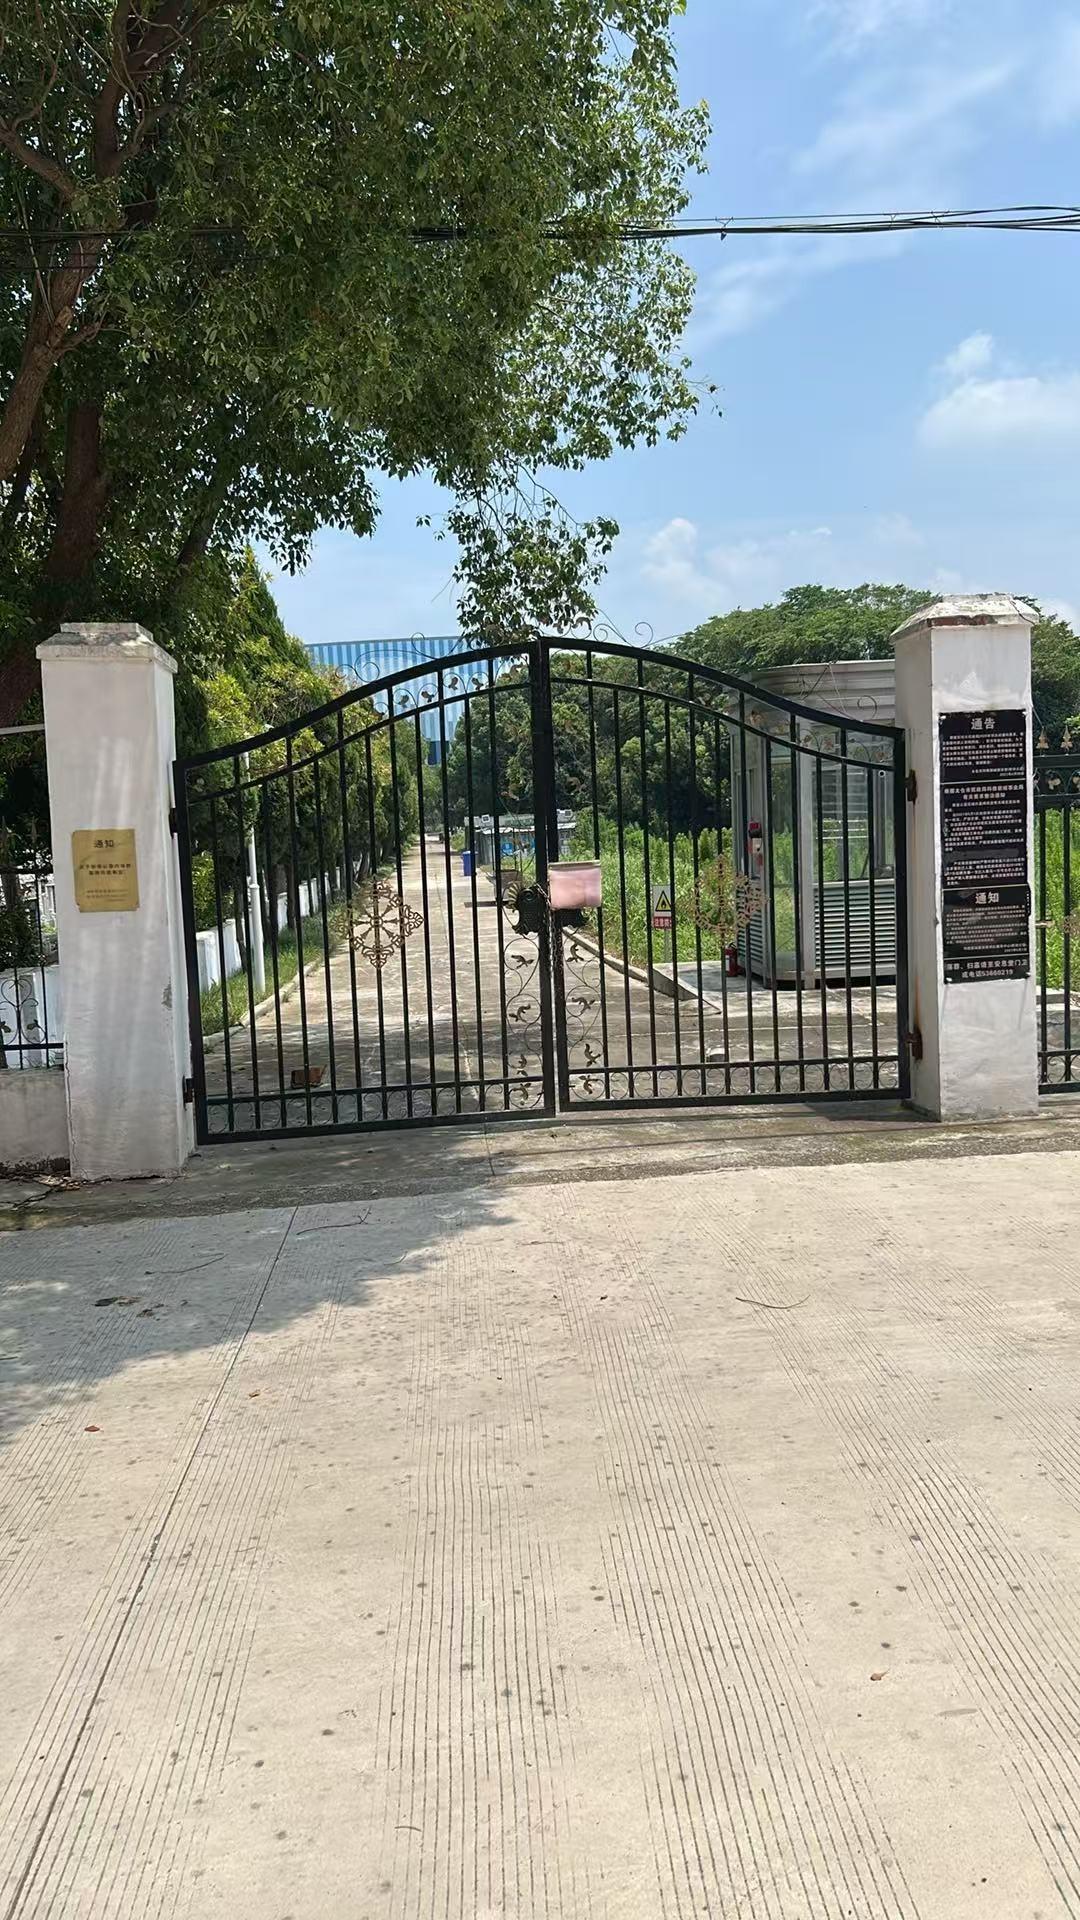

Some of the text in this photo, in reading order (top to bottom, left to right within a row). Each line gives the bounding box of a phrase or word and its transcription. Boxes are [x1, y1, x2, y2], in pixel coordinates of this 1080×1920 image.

[971, 718, 995, 730] 通告
[95, 840, 114, 848] 通知
[975, 892, 999, 904] 通知
